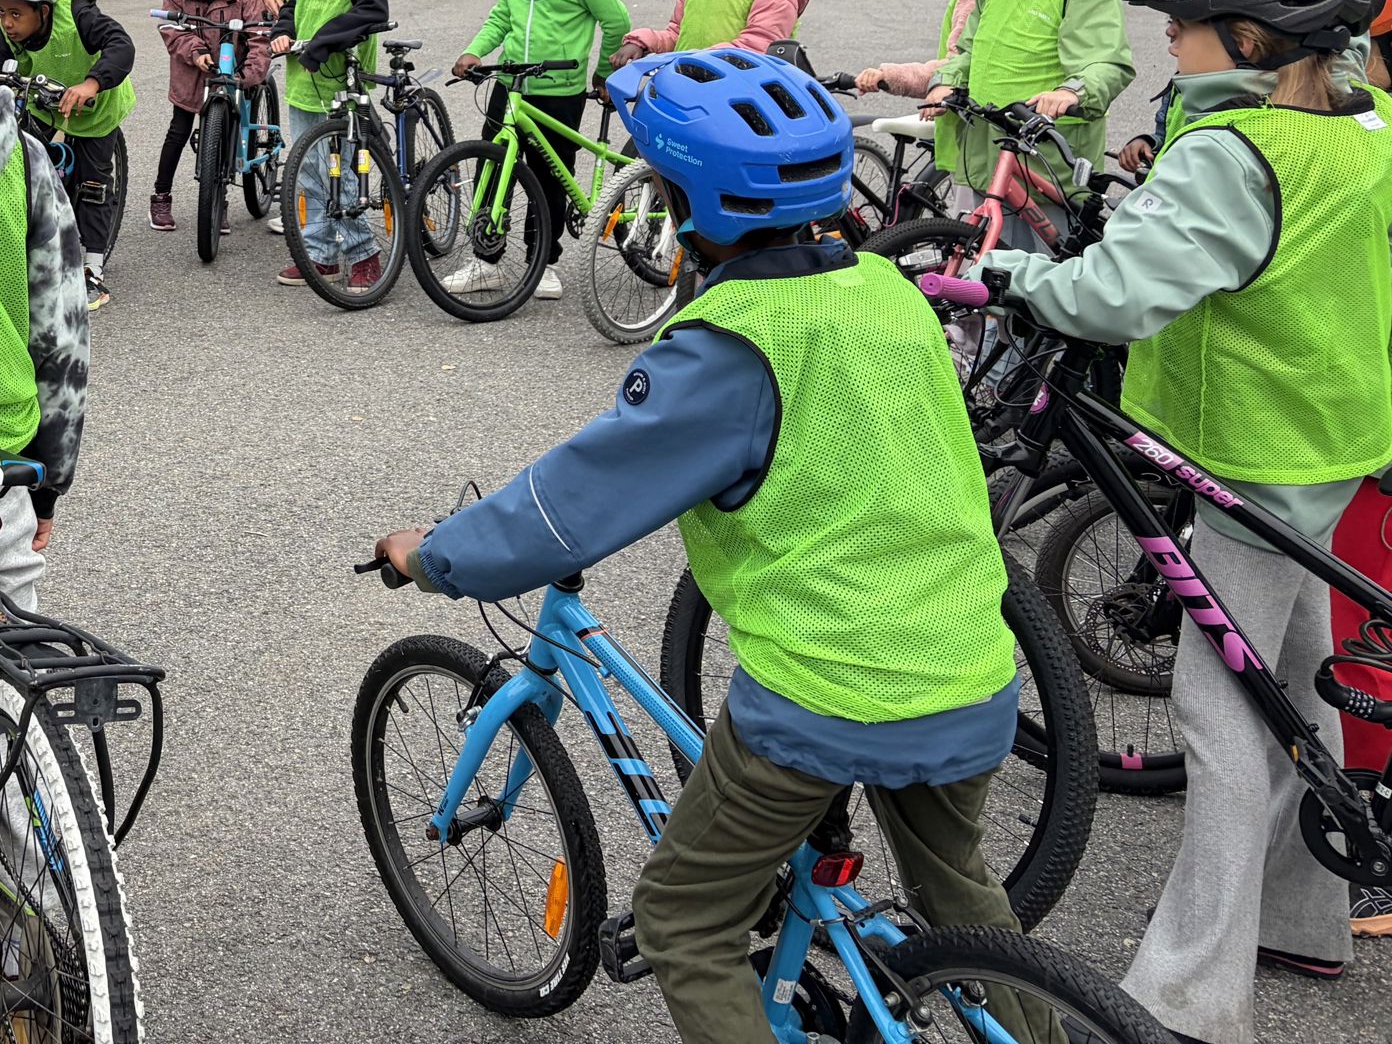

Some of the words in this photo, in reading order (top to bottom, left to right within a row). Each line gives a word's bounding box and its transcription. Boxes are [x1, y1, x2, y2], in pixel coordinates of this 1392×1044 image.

[665, 145, 703, 167] Protection
[666, 137, 688, 153] Sweet
[629, 377, 643, 393] P
[1132, 438, 1174, 465] 260
[1175, 464, 1244, 509] super
[1135, 535, 1264, 672] BITS
